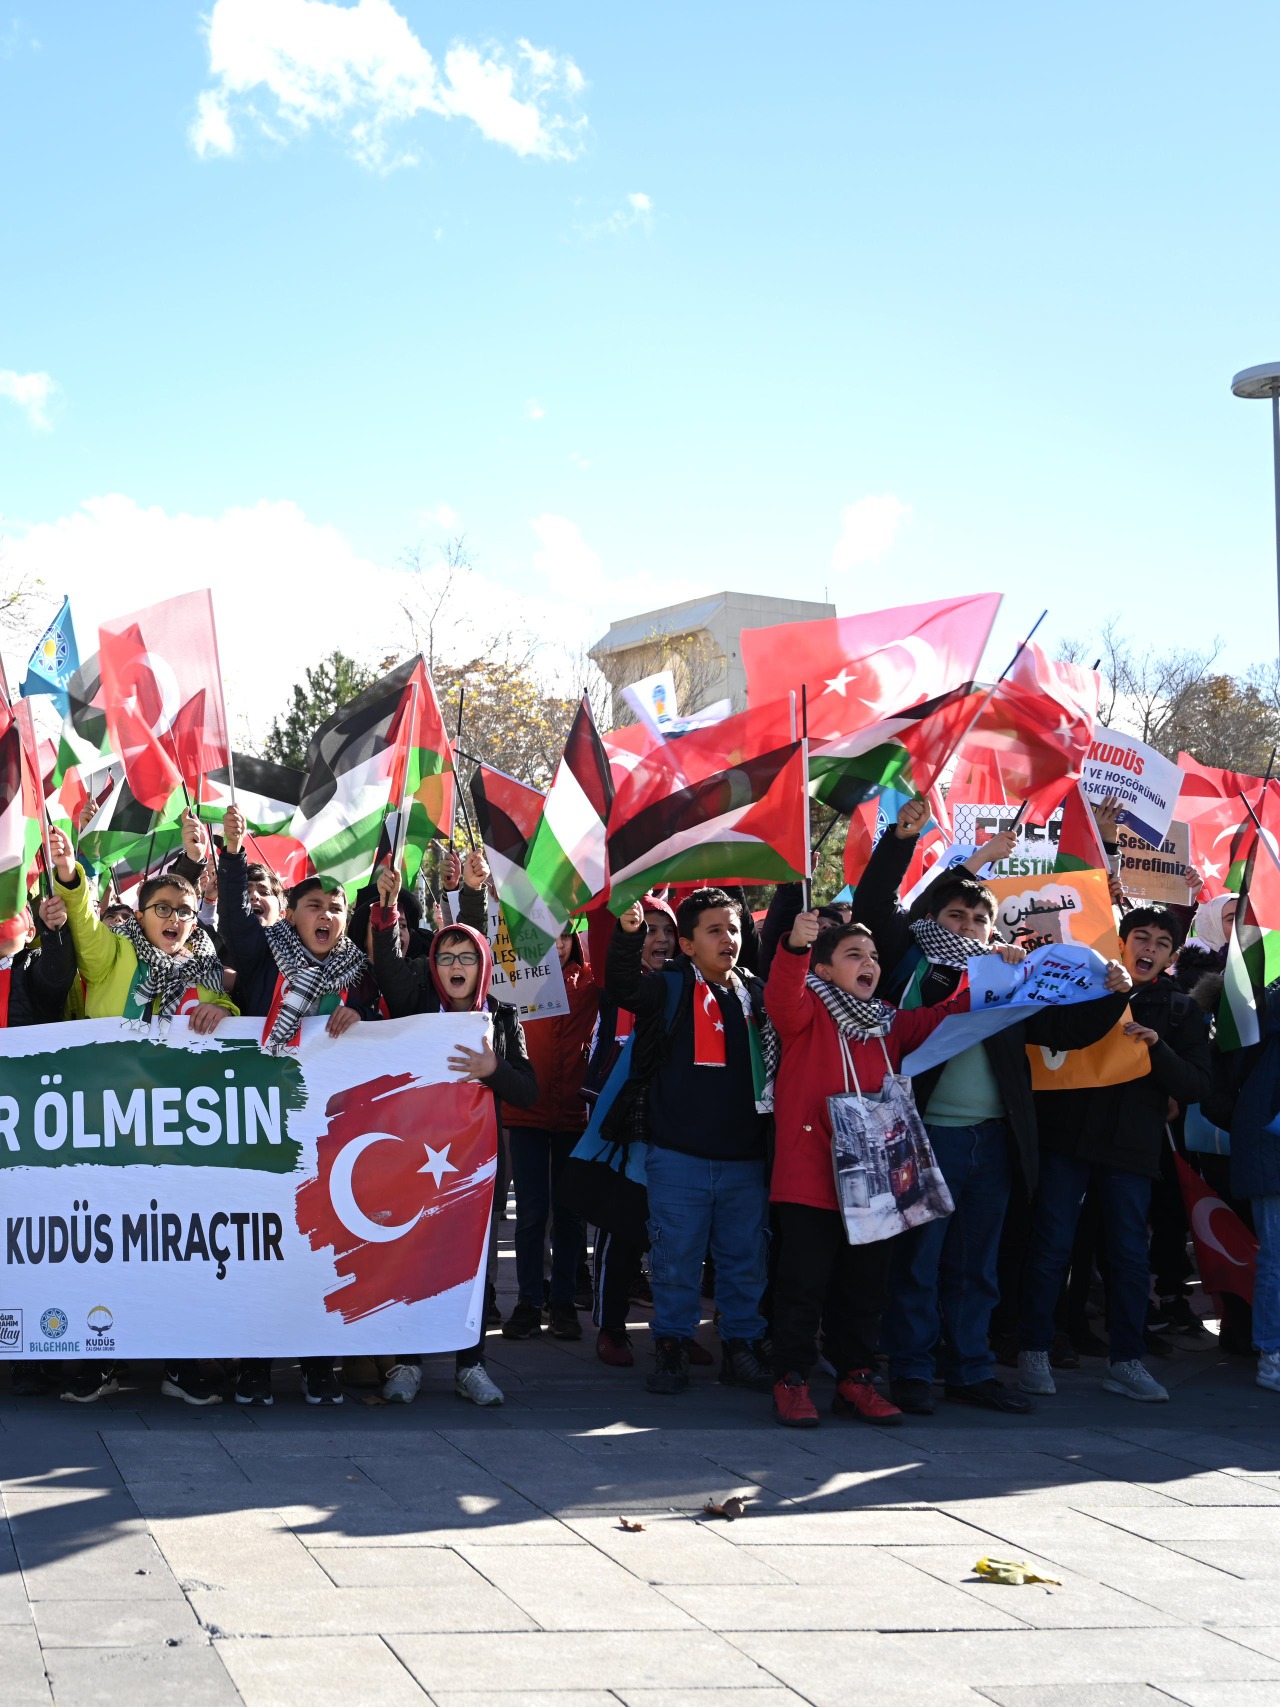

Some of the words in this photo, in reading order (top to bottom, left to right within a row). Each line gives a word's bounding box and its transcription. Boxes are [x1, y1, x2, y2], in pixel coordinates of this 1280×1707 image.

[1086, 740, 1145, 776] KUDÜS
[1082, 781, 1139, 805] AŞKENTİDİR
[1089, 768, 1103, 781] VE
[1104, 770, 1167, 810] HOŞGÖRÜNÜN
[1002, 894, 1077, 927] فلسطين
[491, 972, 507, 986] ILL
[509, 969, 523, 983] BE
[524, 964, 552, 980] FREE
[32, 1068, 283, 1151] ÖLMESİN
[6, 1199, 114, 1265] KUDÜS
[121, 1197, 285, 1281] MİRAÇTIR
[29, 1341, 81, 1353] BİLGEHANE
[85, 1336, 116, 1347] KUDÜS
